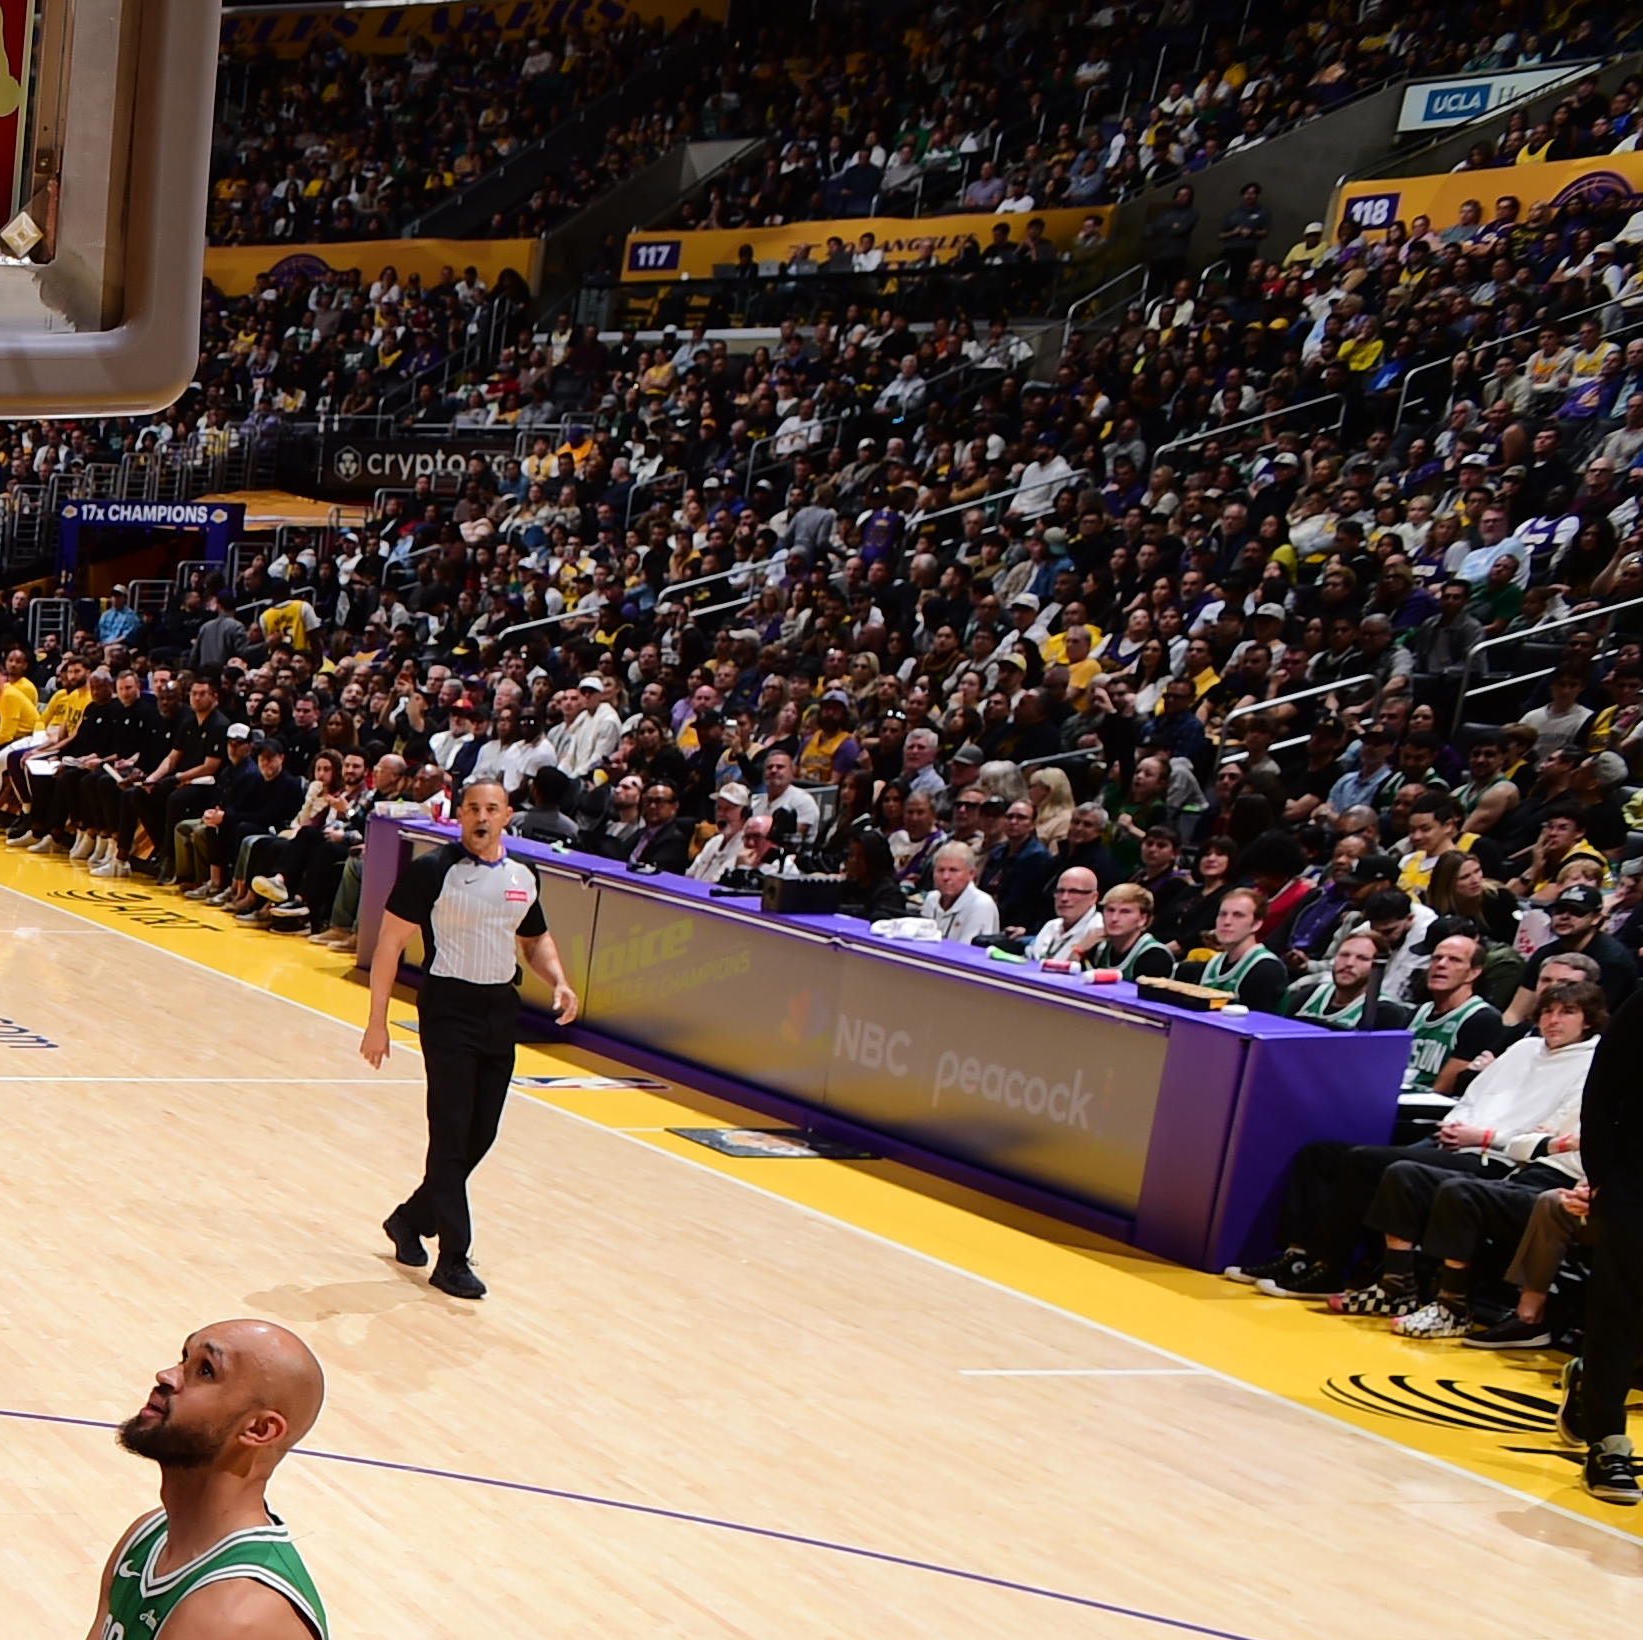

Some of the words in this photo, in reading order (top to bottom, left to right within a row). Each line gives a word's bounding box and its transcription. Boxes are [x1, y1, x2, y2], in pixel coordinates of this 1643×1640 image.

[1433, 91, 1482, 114] UCLA
[1350, 198, 1390, 227] 118
[637, 244, 672, 268] 117
[81, 504, 105, 522] 17x
[107, 503, 208, 525] CHAMPIONS
[833, 1013, 912, 1078] NBC
[931, 1049, 1095, 1130] peacock
